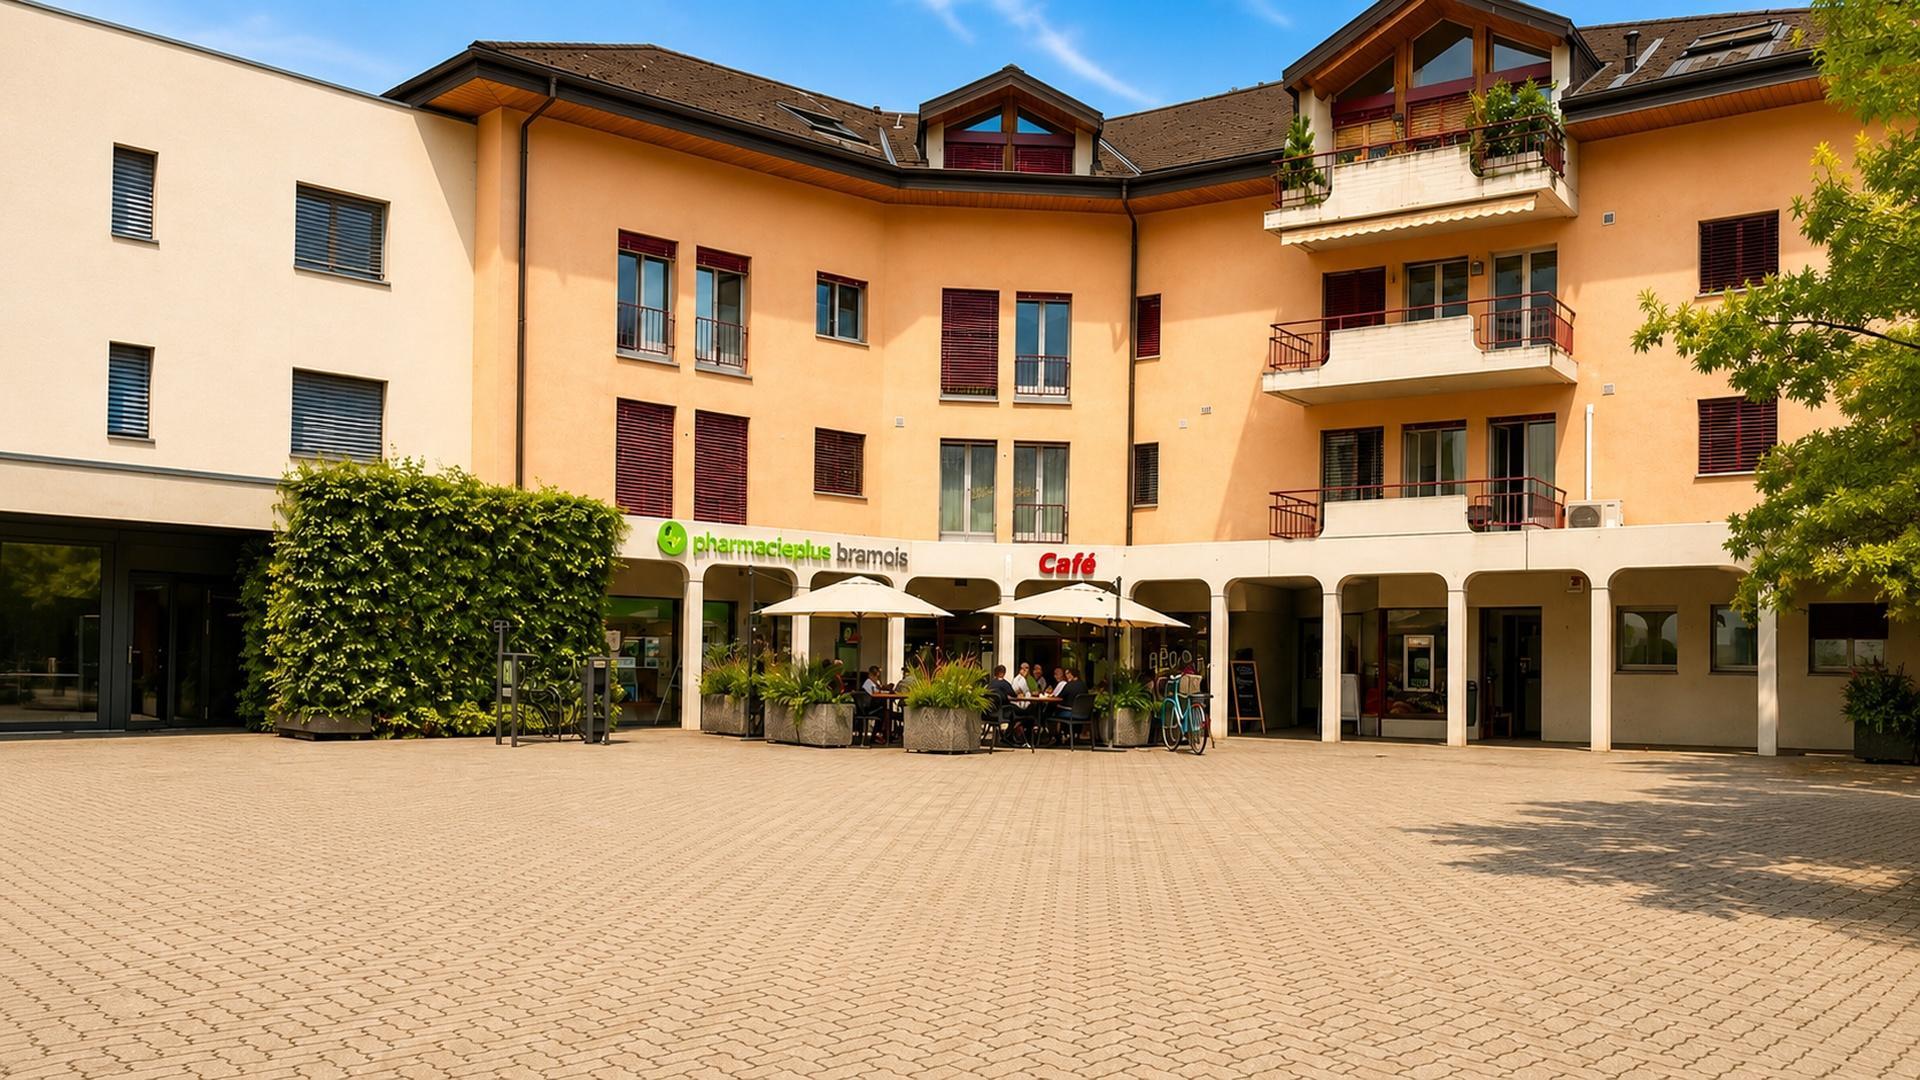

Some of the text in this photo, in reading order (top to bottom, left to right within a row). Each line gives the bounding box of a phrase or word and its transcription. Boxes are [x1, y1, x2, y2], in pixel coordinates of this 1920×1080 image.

[693, 531, 908, 567] pharmacieplus bramois
[1039, 552, 1096, 575] Café
